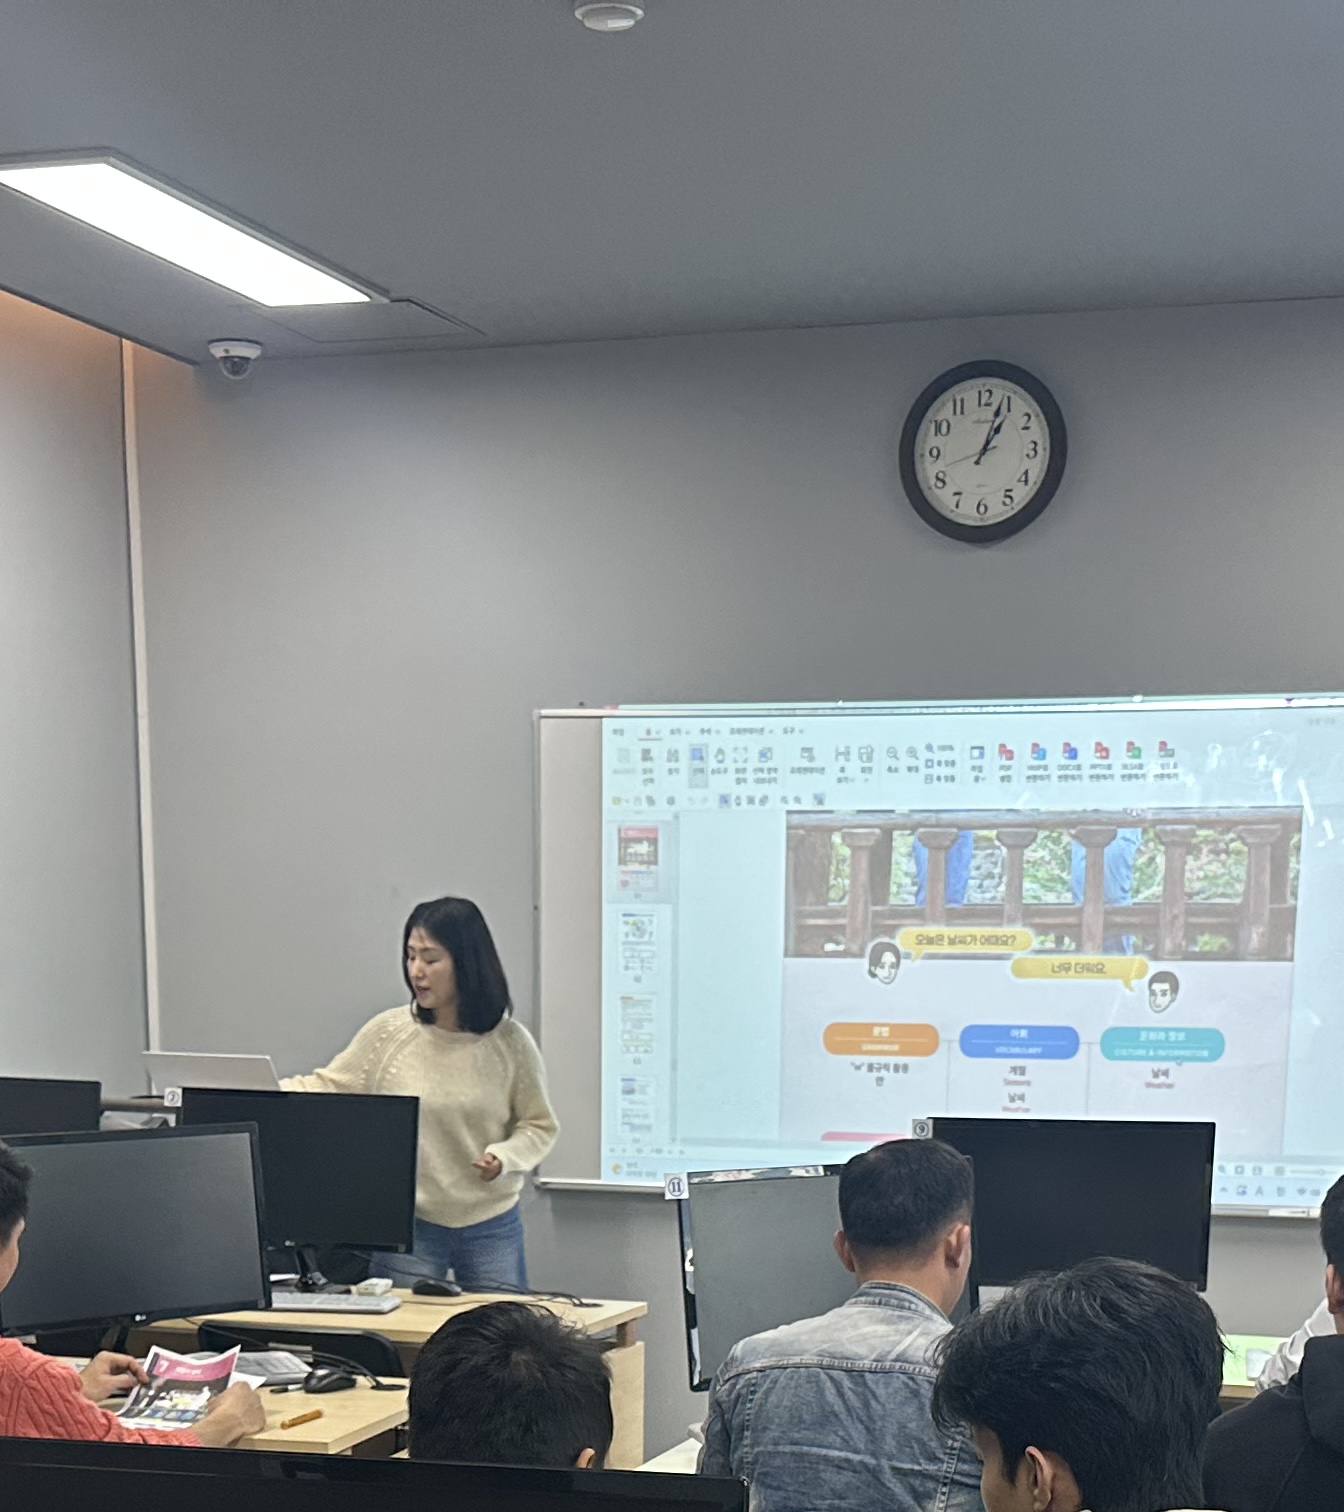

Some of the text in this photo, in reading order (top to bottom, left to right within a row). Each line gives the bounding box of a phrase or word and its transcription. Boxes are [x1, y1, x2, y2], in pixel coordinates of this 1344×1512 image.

[952, 397, 965, 416] 11
[977, 389, 993, 407] 12
[1006, 395, 1012, 413] 1
[932, 418, 951, 437] 10
[1021, 412, 1032, 431] 2
[929, 446, 941, 463] 9
[1025, 440, 1038, 459] 3
[934, 470, 947, 489] 8
[1017, 469, 1029, 486] 4
[952, 491, 963, 509] 7
[976, 497, 988, 516] 6
[1002, 488, 1014, 507] 5
